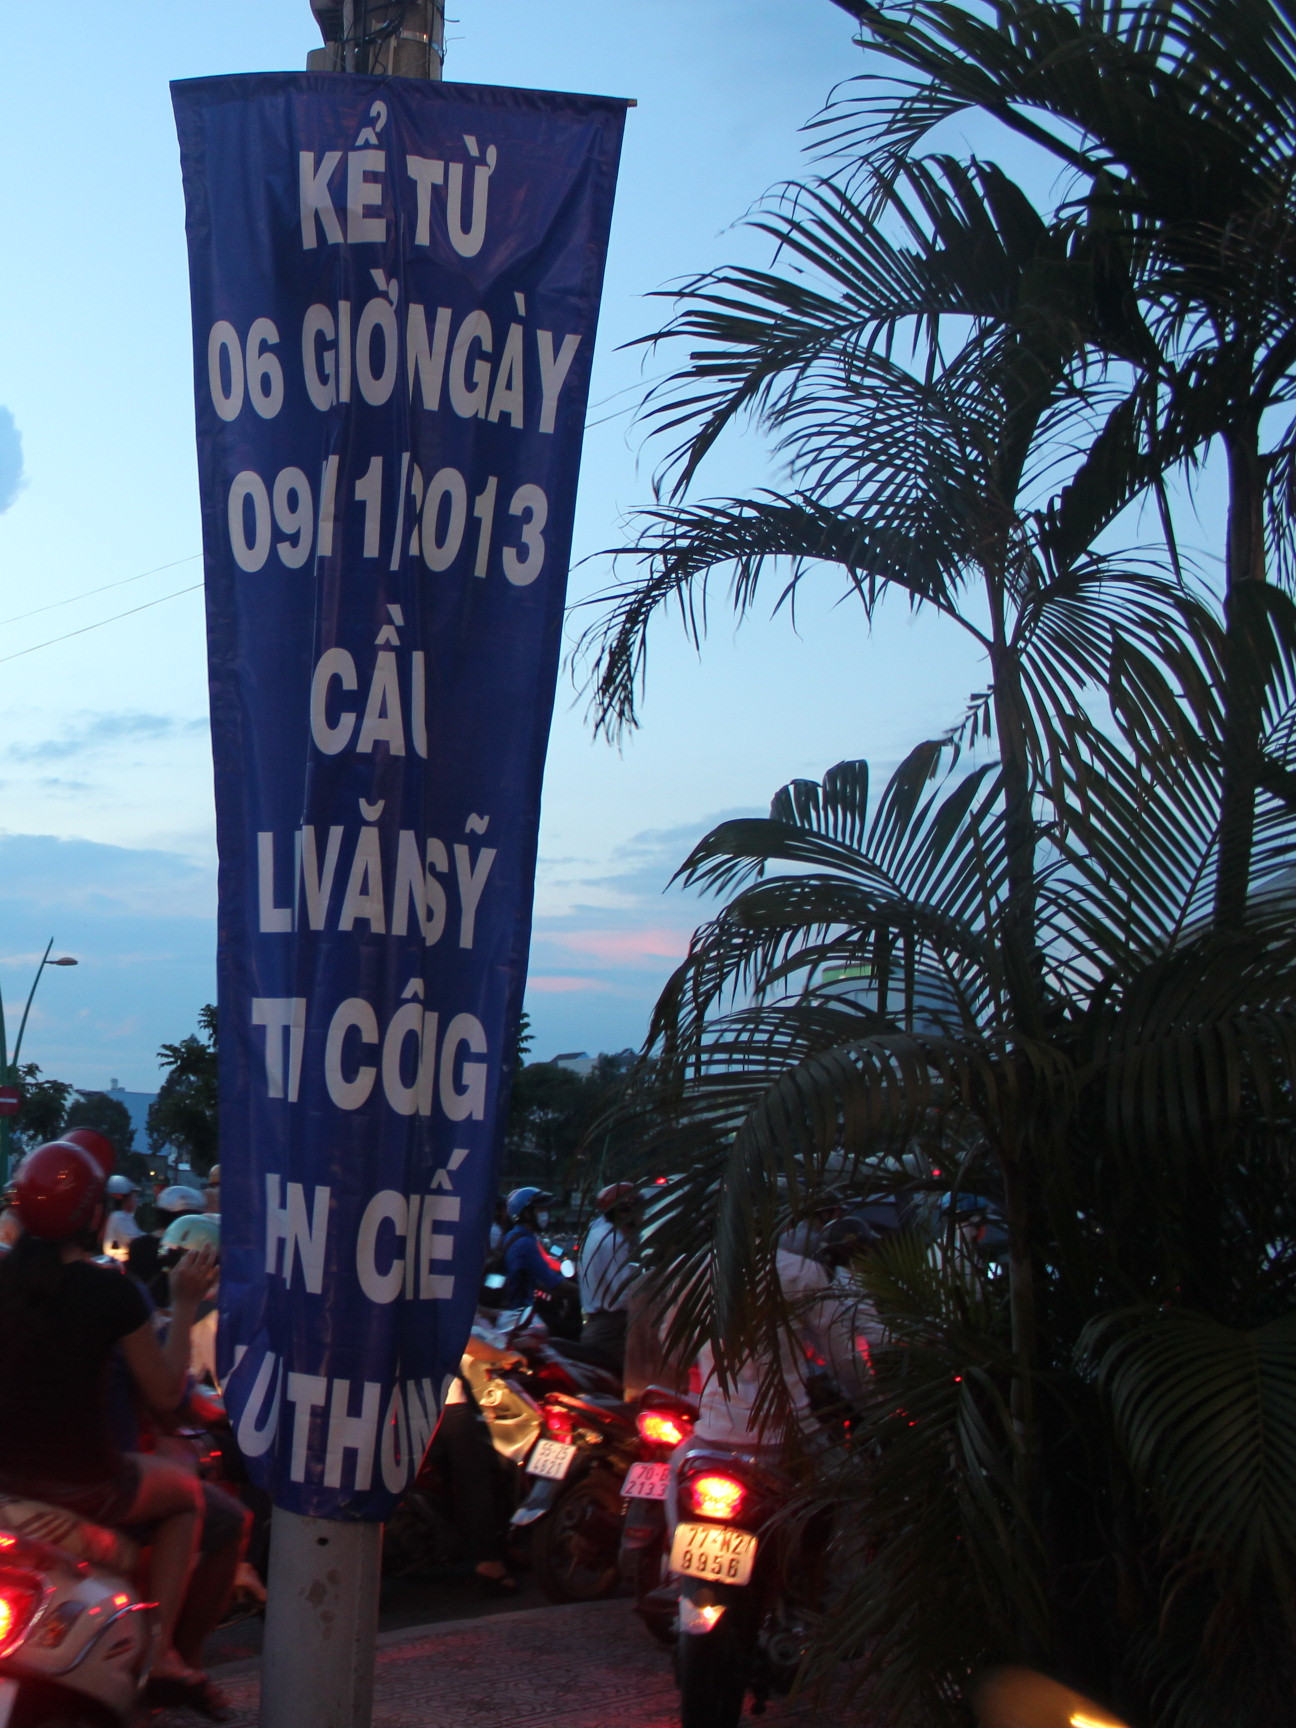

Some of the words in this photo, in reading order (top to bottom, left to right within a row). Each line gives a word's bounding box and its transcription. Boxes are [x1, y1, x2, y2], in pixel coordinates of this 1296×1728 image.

[299, 100, 388, 250] KỂ
[406, 133, 497, 257] TỪ
[207, 317, 284, 422] 06
[302, 268, 399, 412] GIỜ
[406, 291, 582, 434] NGÀY
[257, 824, 302, 933] L
